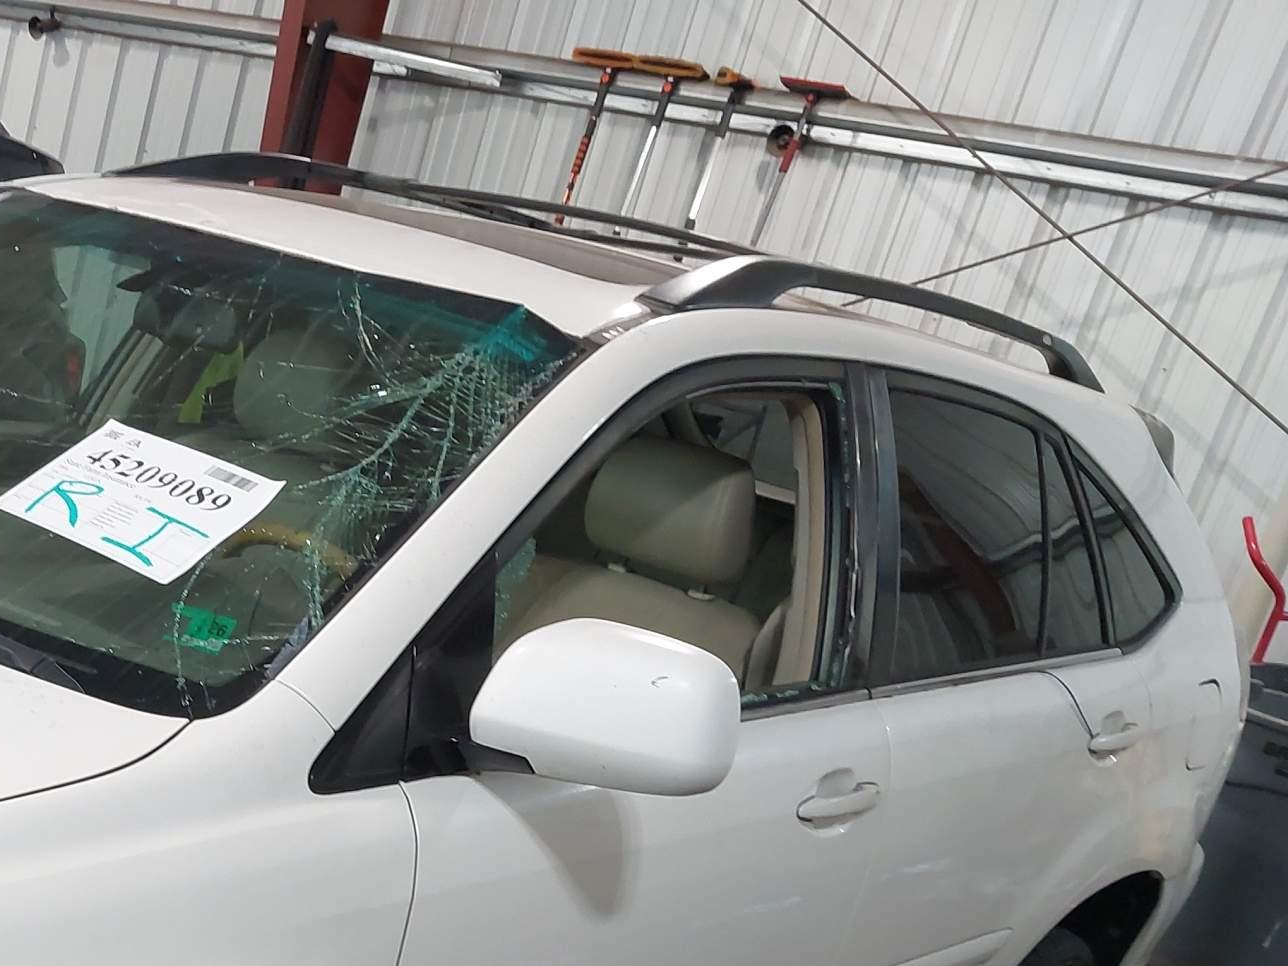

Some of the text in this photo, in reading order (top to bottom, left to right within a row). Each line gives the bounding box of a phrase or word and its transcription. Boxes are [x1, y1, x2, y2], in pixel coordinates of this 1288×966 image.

[86, 449, 233, 512] 45209089
[24, 479, 105, 528] R
[101, 506, 210, 568] I
